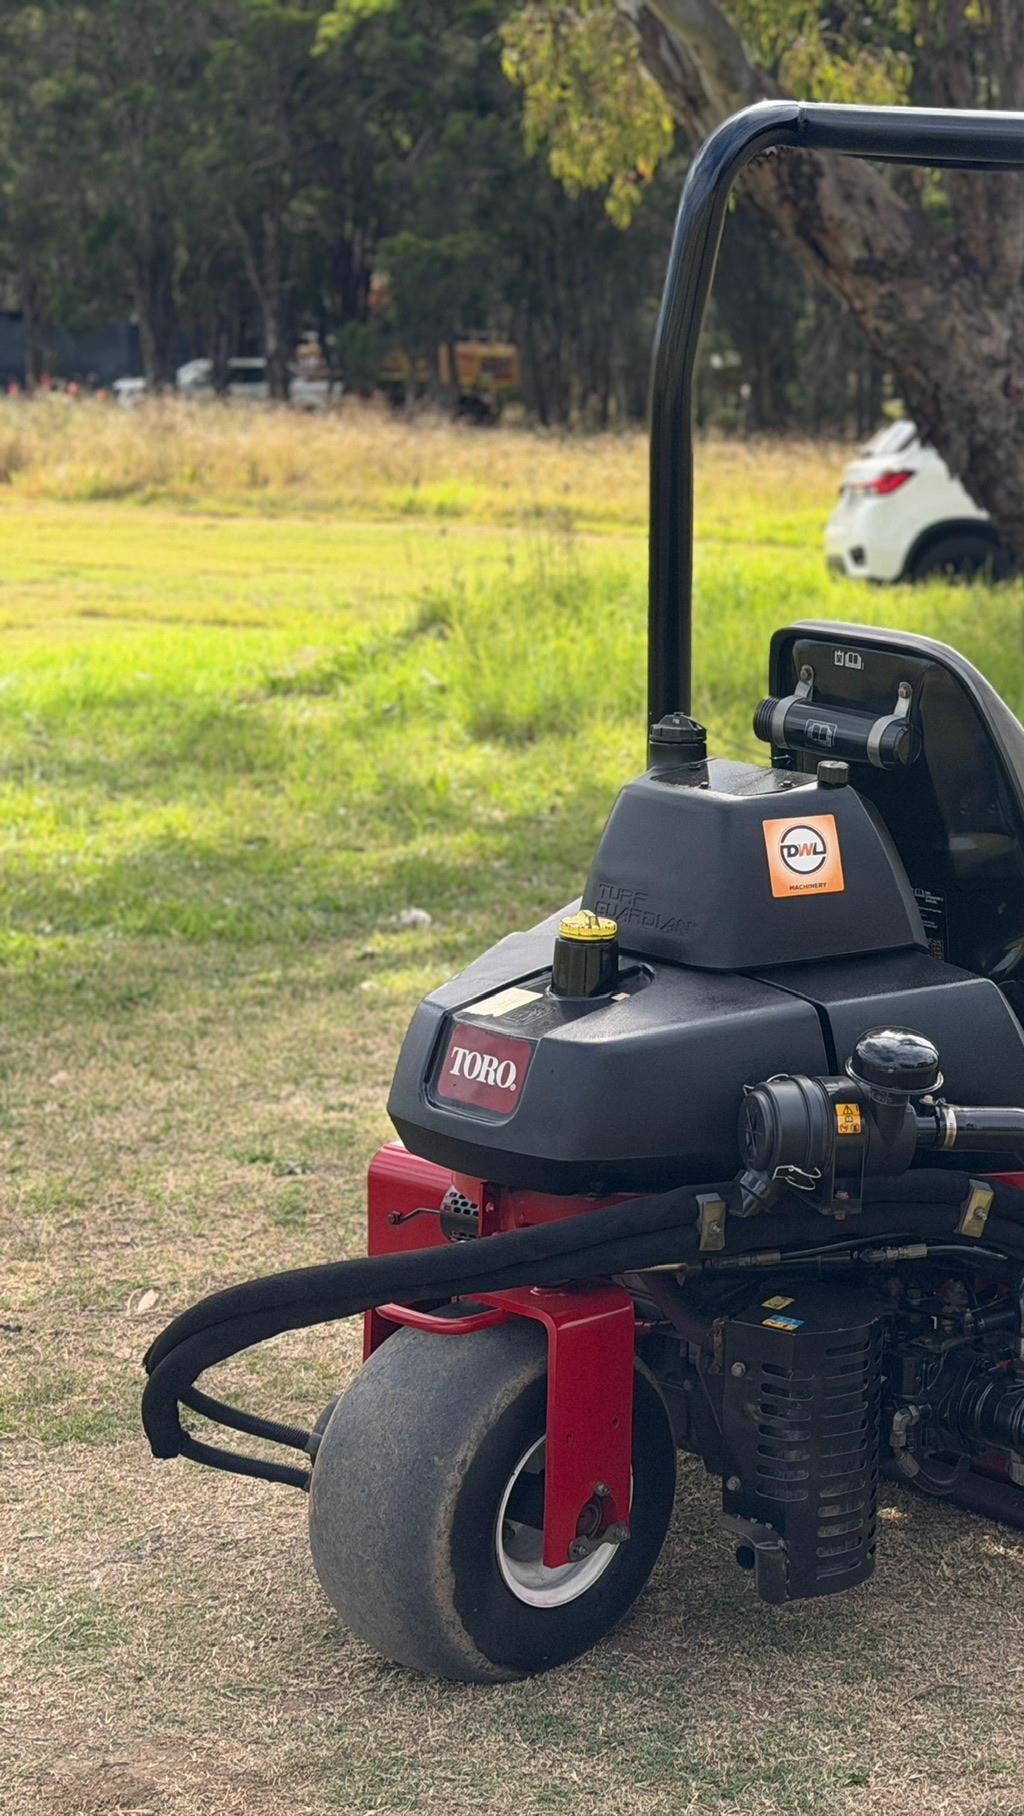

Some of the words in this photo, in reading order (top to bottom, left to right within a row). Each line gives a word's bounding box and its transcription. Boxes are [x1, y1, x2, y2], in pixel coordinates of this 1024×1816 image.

[781, 842, 826, 858] DWL
[599, 883, 648, 906] TURF
[789, 882, 827, 891] MACHINERY
